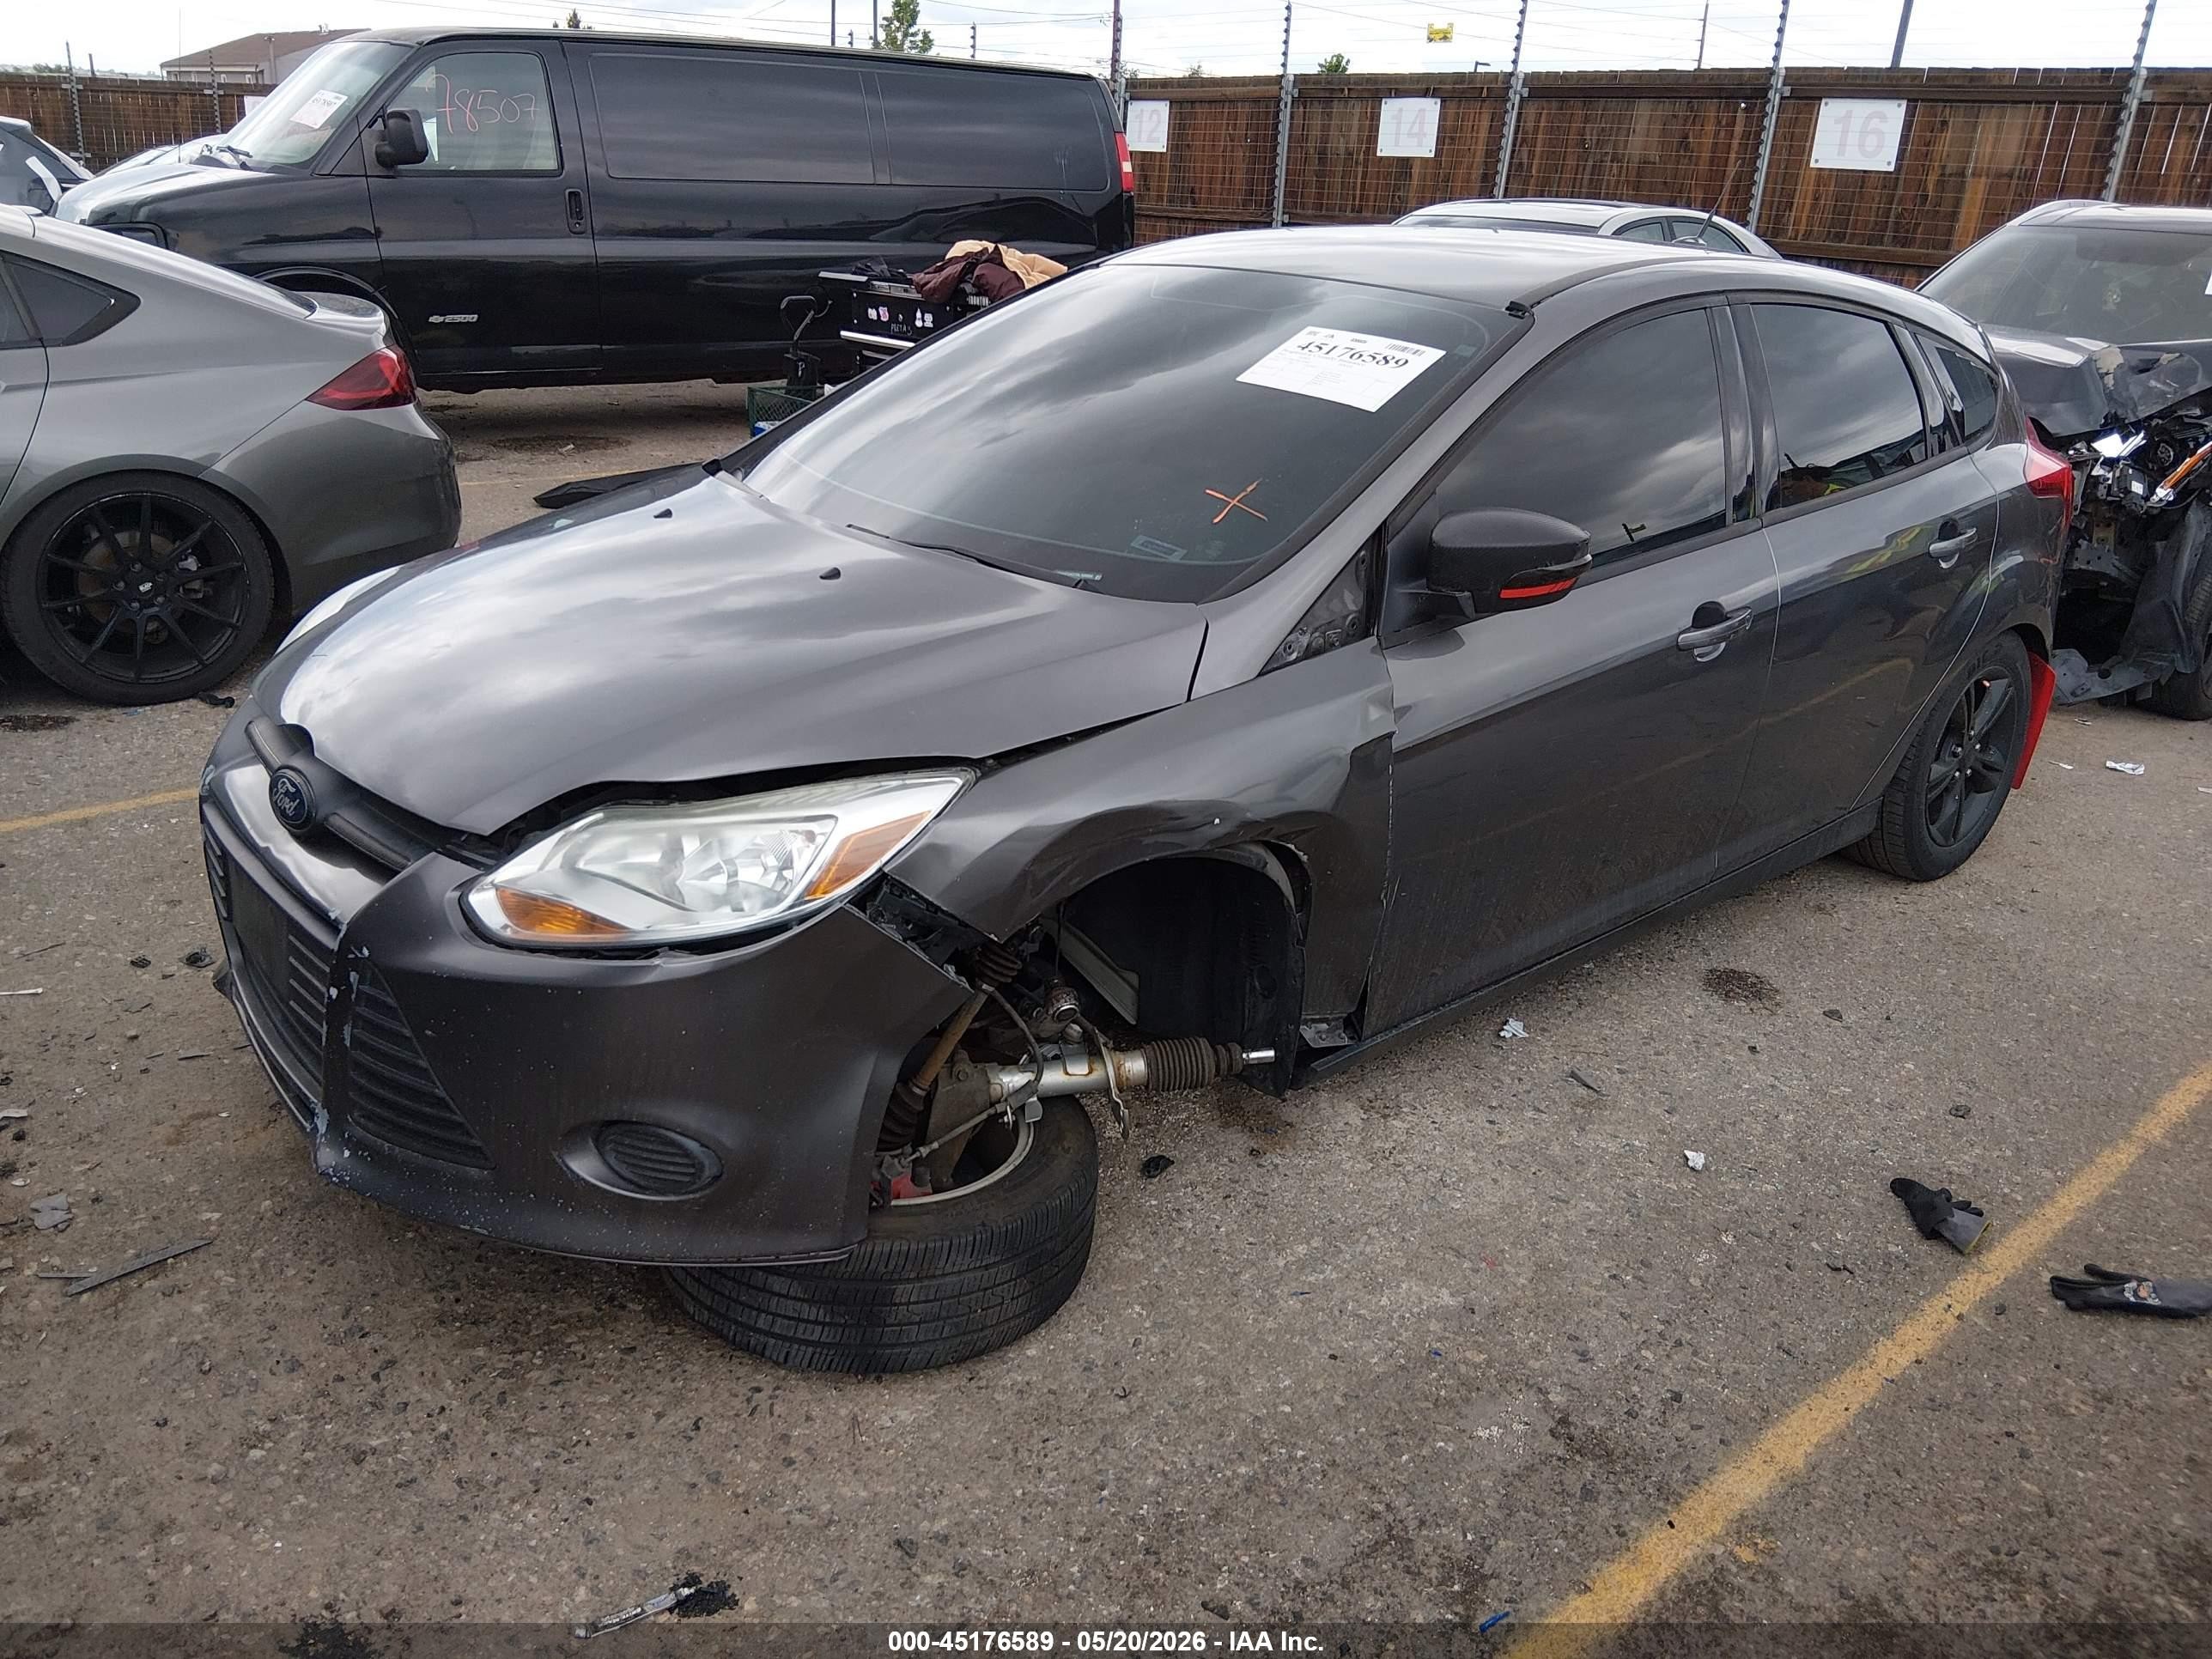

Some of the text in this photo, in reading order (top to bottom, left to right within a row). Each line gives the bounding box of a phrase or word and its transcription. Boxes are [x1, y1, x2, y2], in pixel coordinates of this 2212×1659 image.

[425, 73, 540, 135] 78507
[1134, 108, 1162, 143] 12
[1390, 107, 1427, 148] 14
[1834, 109, 1889, 159] 16
[445, 314, 478, 323] 2500
[1297, 341, 1409, 368] 45176589
[272, 778, 300, 817] Ford
